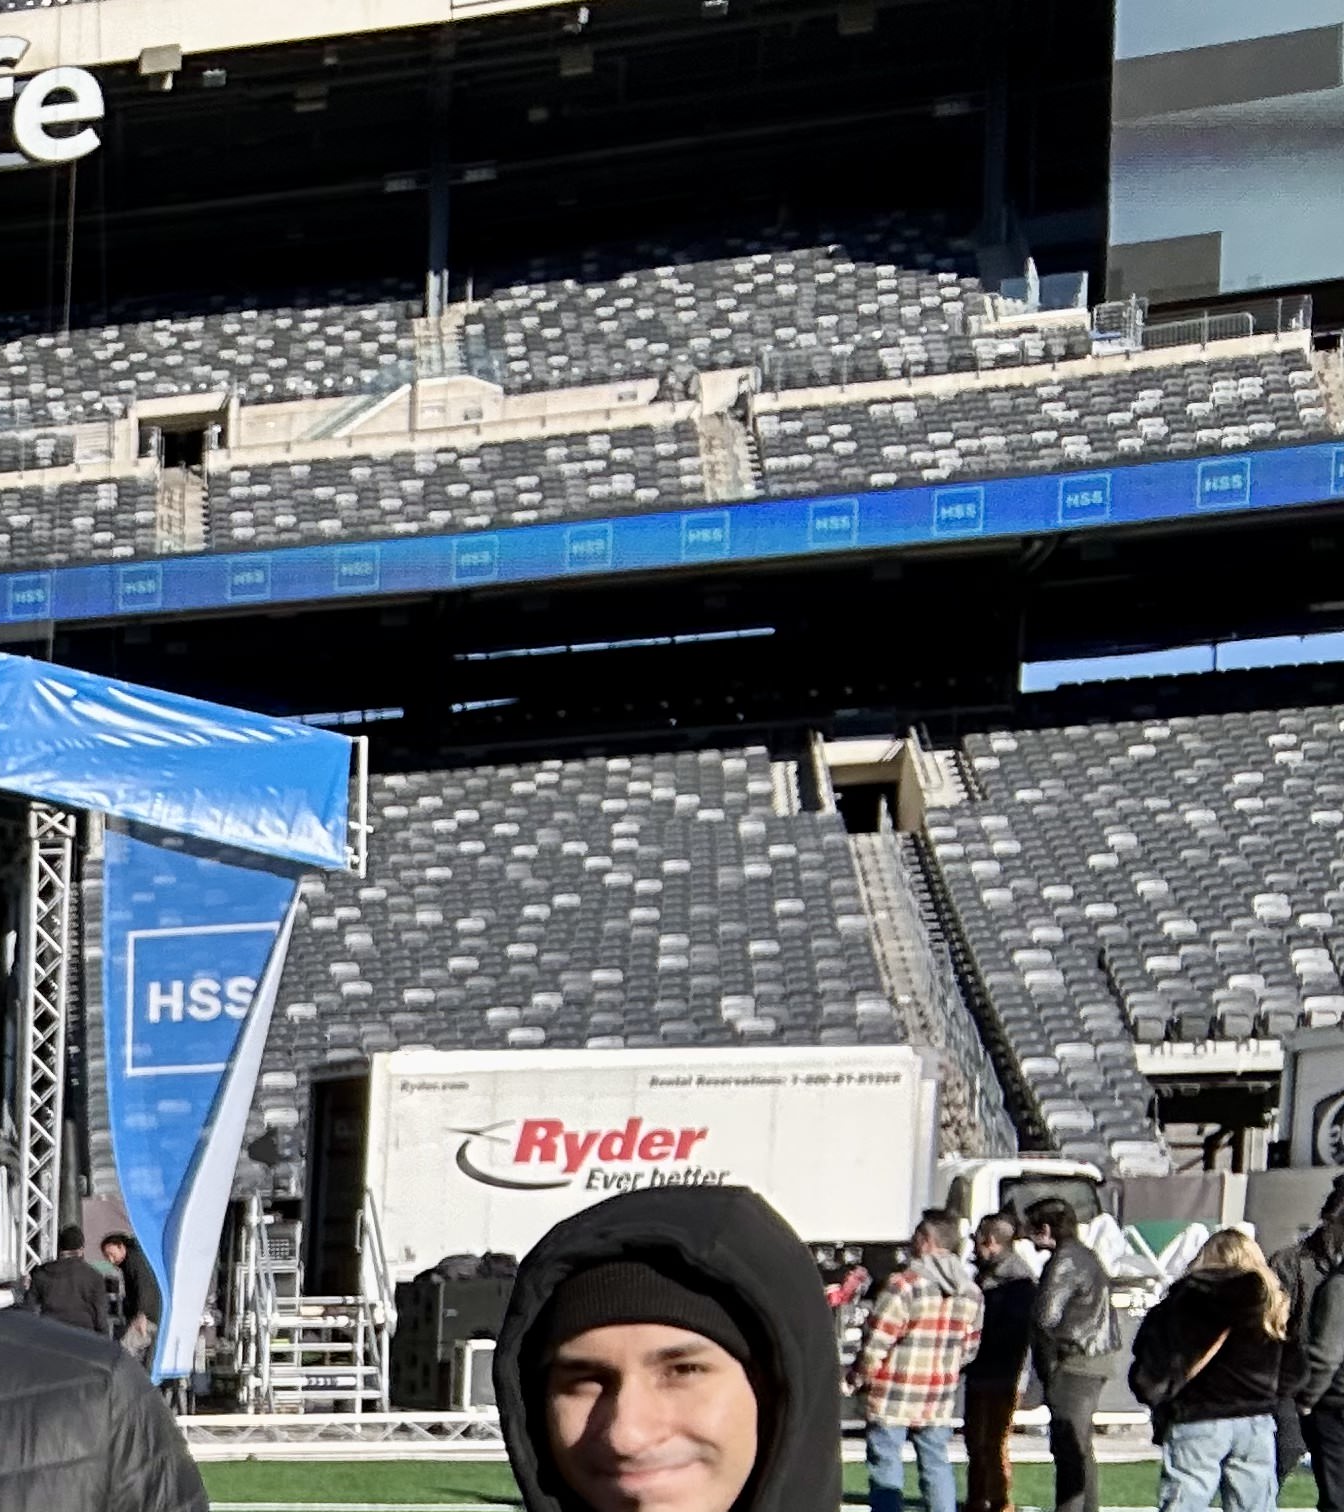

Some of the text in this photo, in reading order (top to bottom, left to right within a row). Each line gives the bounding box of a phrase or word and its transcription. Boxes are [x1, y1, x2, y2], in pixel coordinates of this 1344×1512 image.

[148, 976, 258, 1023] HSS
[513, 1116, 709, 1174] Ryder
[585, 1164, 730, 1192] Ever better
